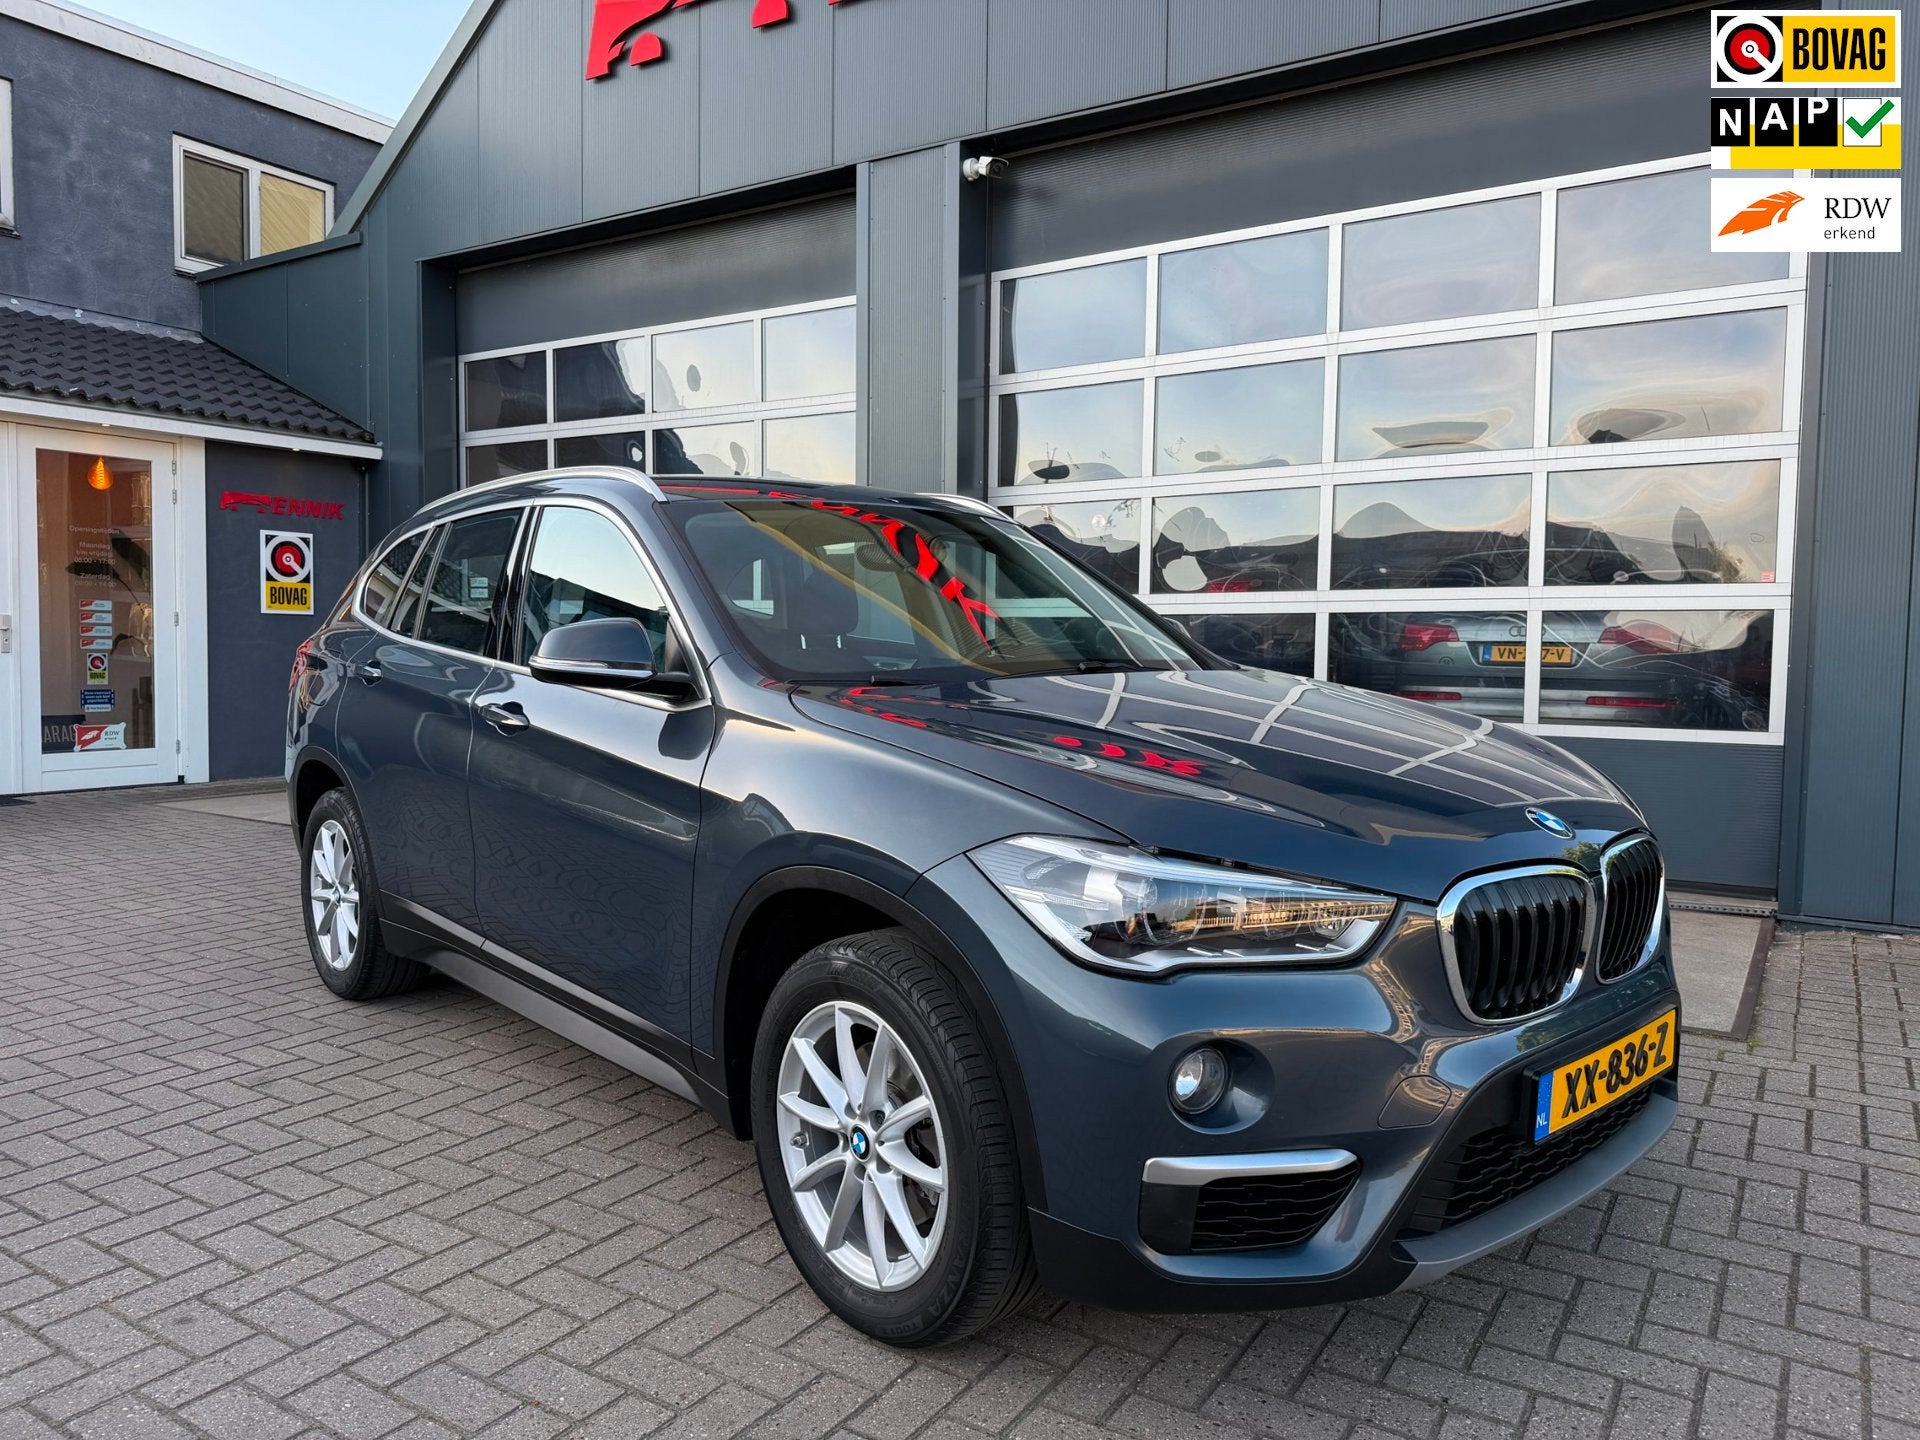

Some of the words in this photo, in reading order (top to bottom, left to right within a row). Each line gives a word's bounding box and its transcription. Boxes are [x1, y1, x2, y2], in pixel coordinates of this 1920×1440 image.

[270, 586, 307, 606] BOVAG
[1561, 1021, 1669, 1119] XX-836-Z
[1536, 1112, 1548, 1128] NL
